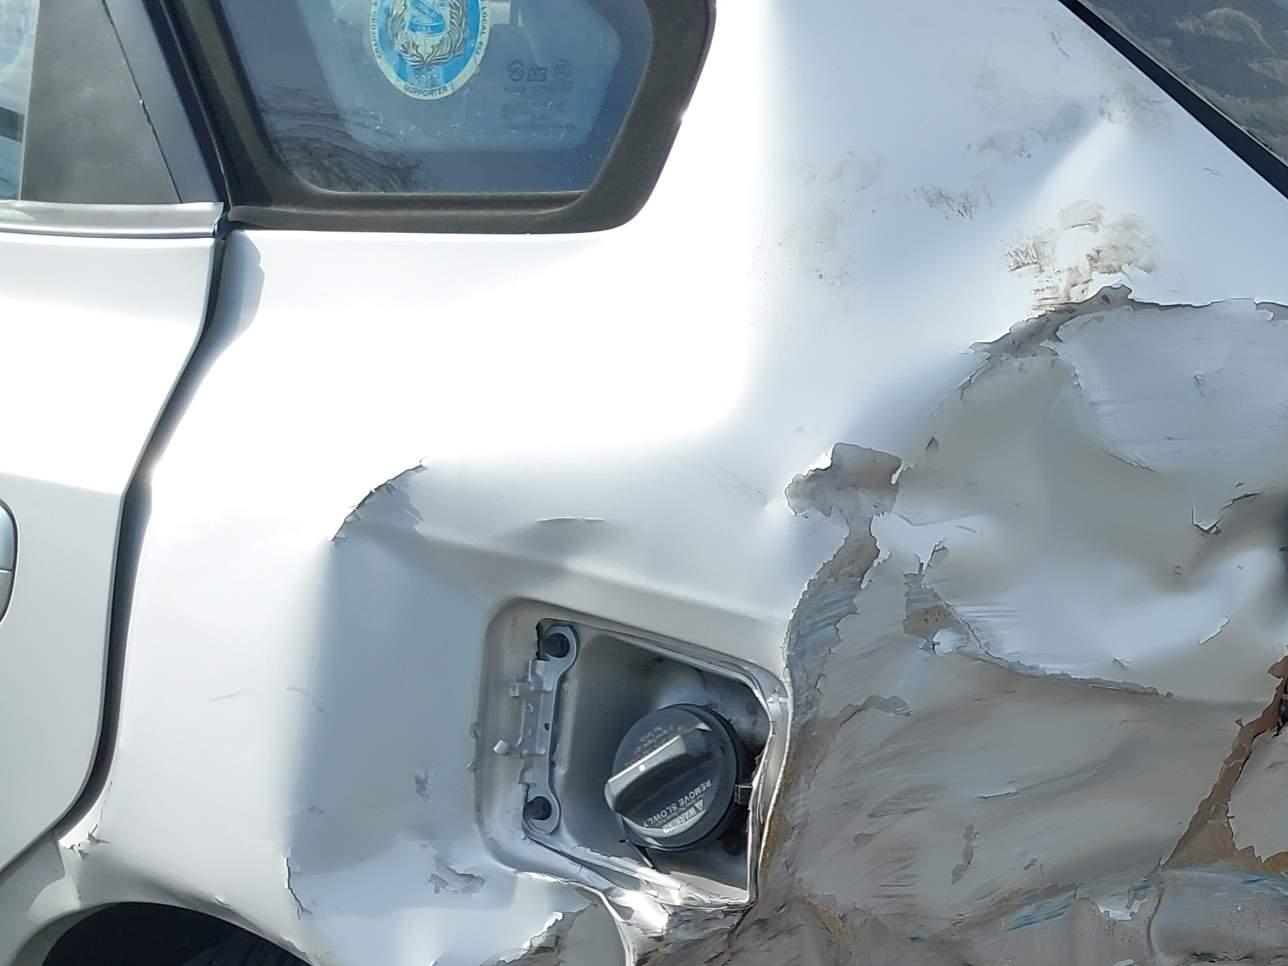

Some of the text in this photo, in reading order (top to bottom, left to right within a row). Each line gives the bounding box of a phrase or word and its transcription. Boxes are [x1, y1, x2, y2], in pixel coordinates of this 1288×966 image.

[403, 85, 448, 97] SUPPORTER
[678, 779, 713, 806] REMOVE
[643, 802, 678, 828] SLOWLY
